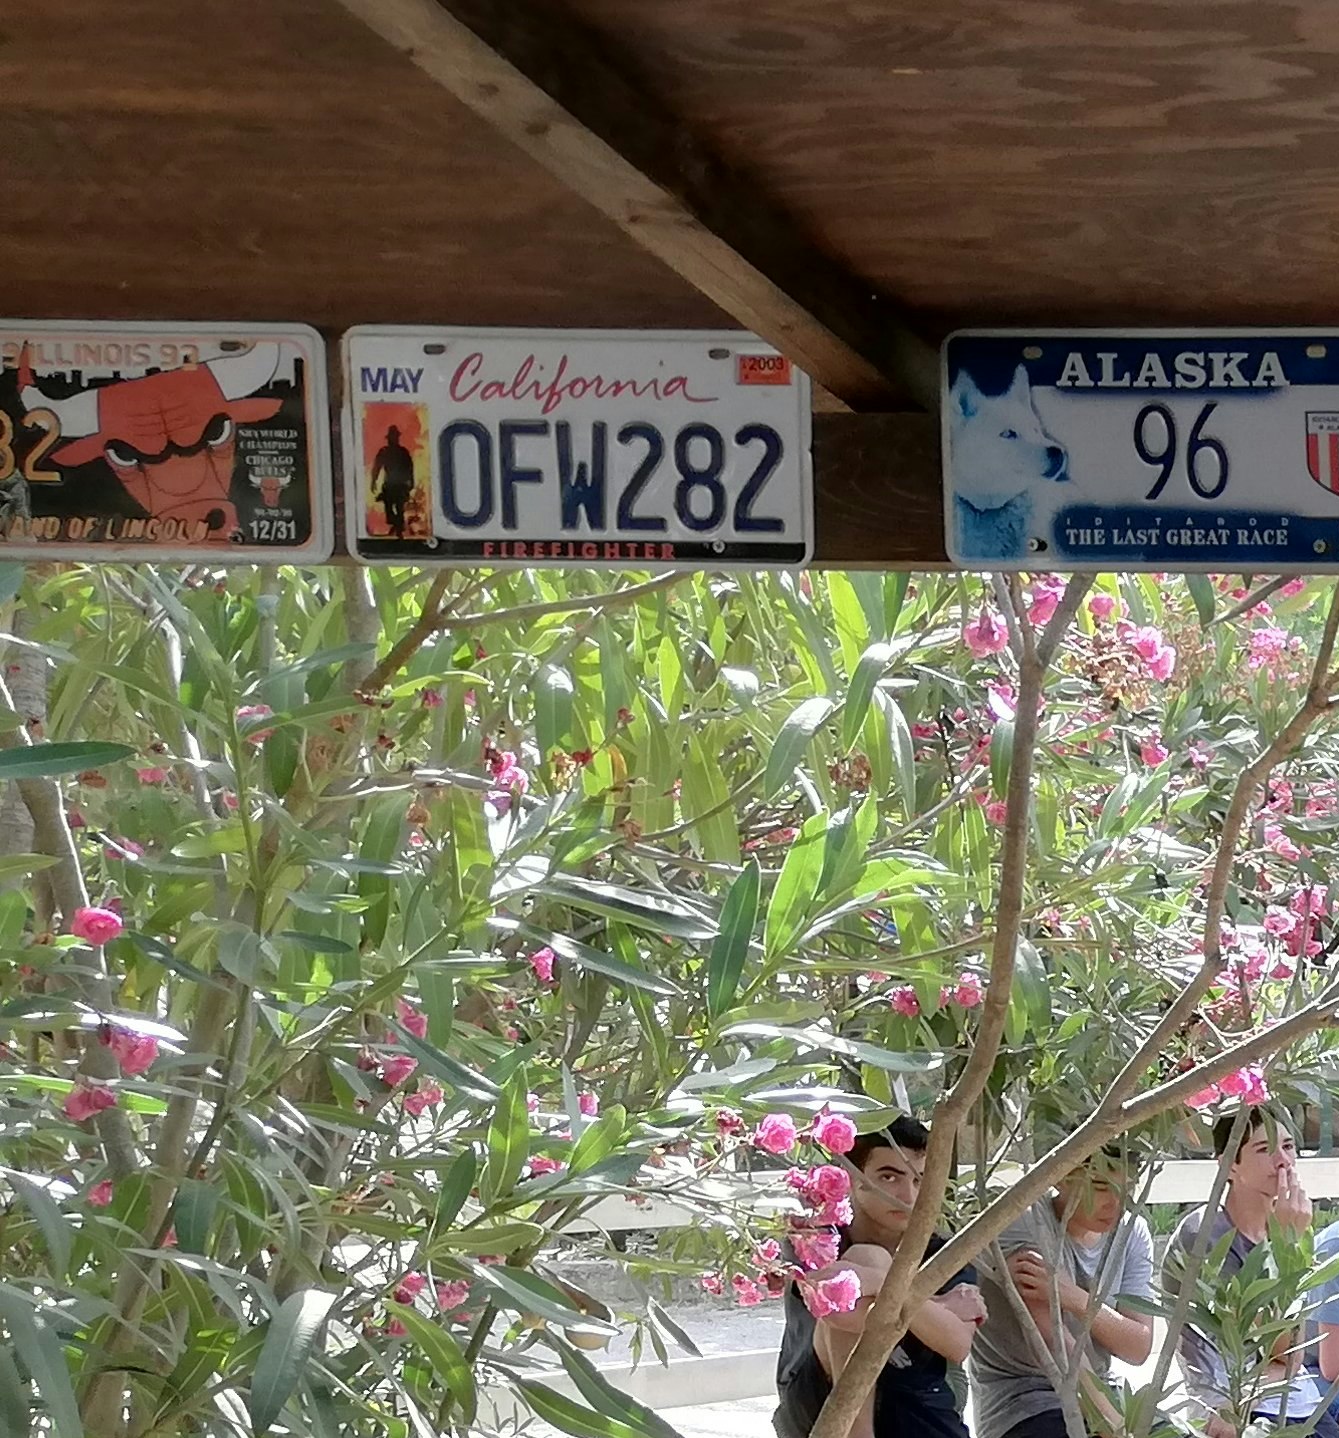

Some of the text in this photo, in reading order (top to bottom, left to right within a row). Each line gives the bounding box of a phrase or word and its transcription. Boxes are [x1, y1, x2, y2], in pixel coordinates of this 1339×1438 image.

[27, 342, 152, 368] ILLINOIS
[749, 357, 784, 371] 2003
[360, 367, 425, 394] MAY
[1055, 351, 1290, 389] ALASKA
[448, 352, 719, 415] California
[245, 455, 294, 466] CHICAGO
[1133, 402, 1229, 500] 96
[0, 516, 61, 540] AND
[68, 516, 99, 540] OF
[248, 520, 296, 541] 12/31
[1066, 528, 1289, 546] THE LAST GREAT RACE
[482, 541, 677, 560] FIREFIGHTER
